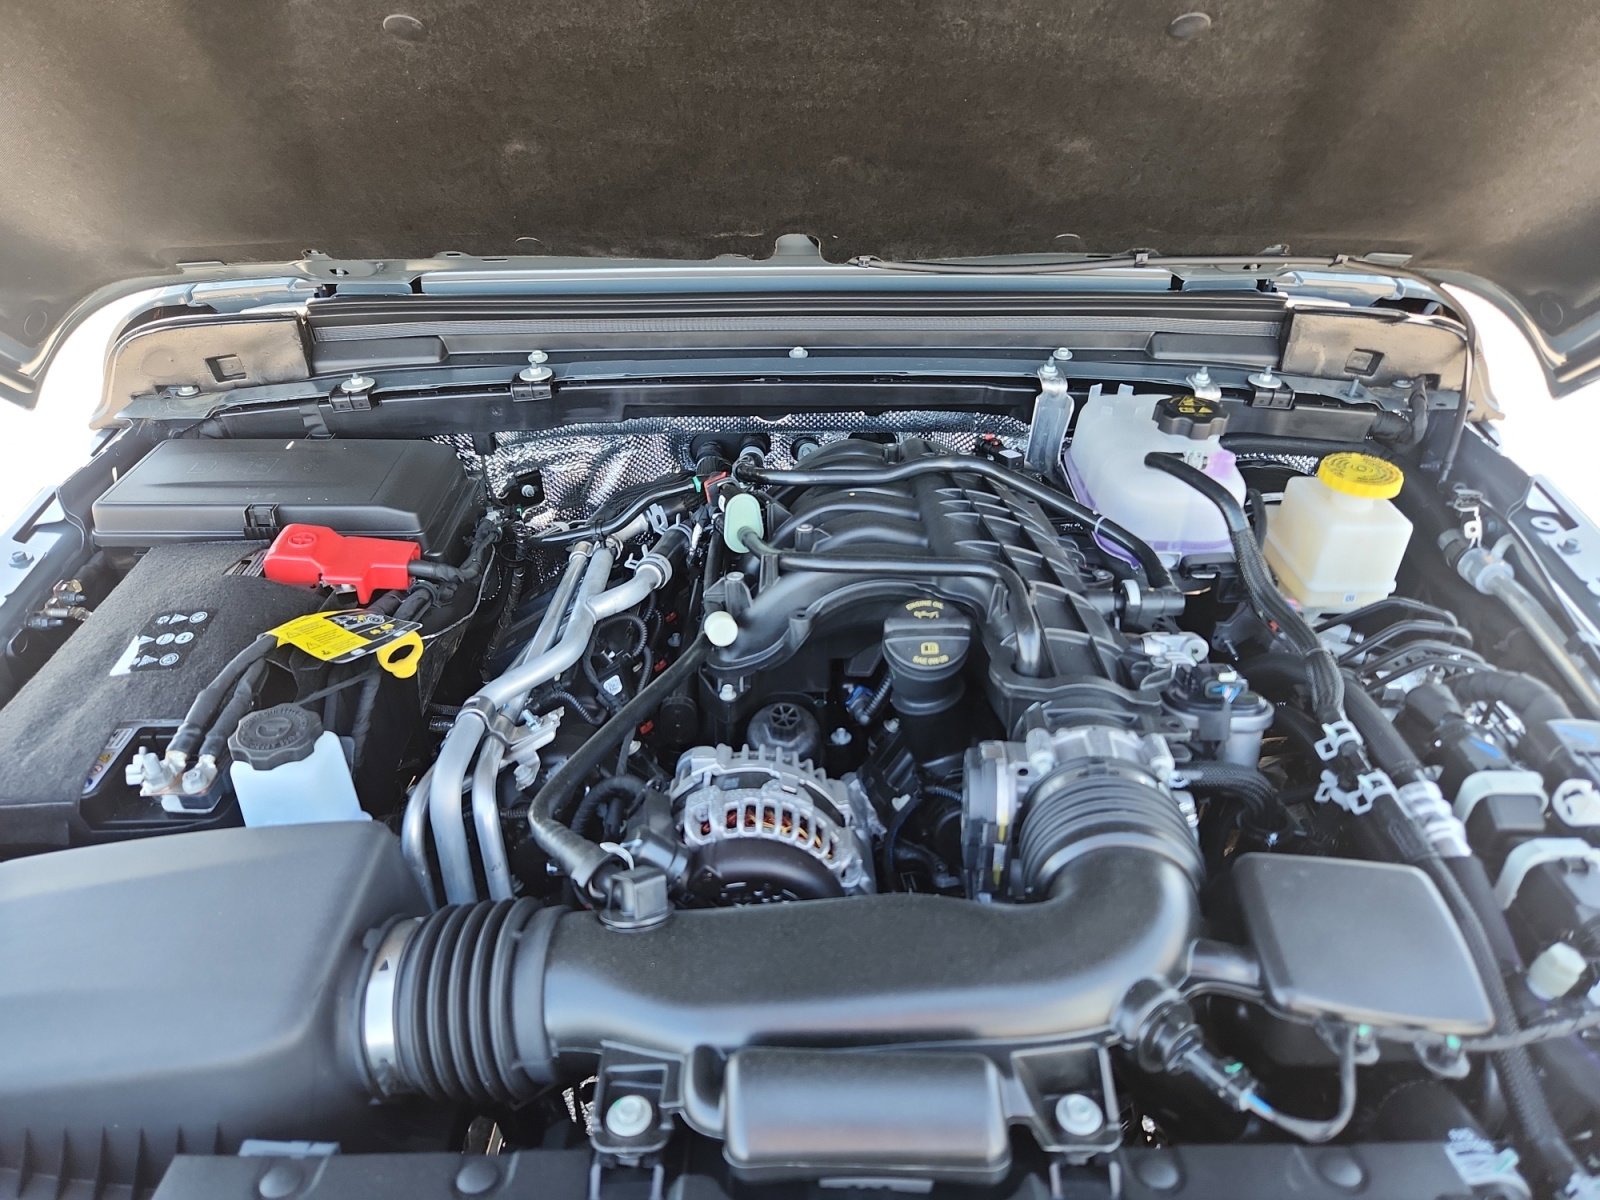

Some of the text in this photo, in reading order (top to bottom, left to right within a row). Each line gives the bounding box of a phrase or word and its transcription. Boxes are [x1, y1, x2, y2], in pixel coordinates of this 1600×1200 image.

[905, 600, 944, 611] ENGINE OIL
[912, 655, 928, 665] SAE
